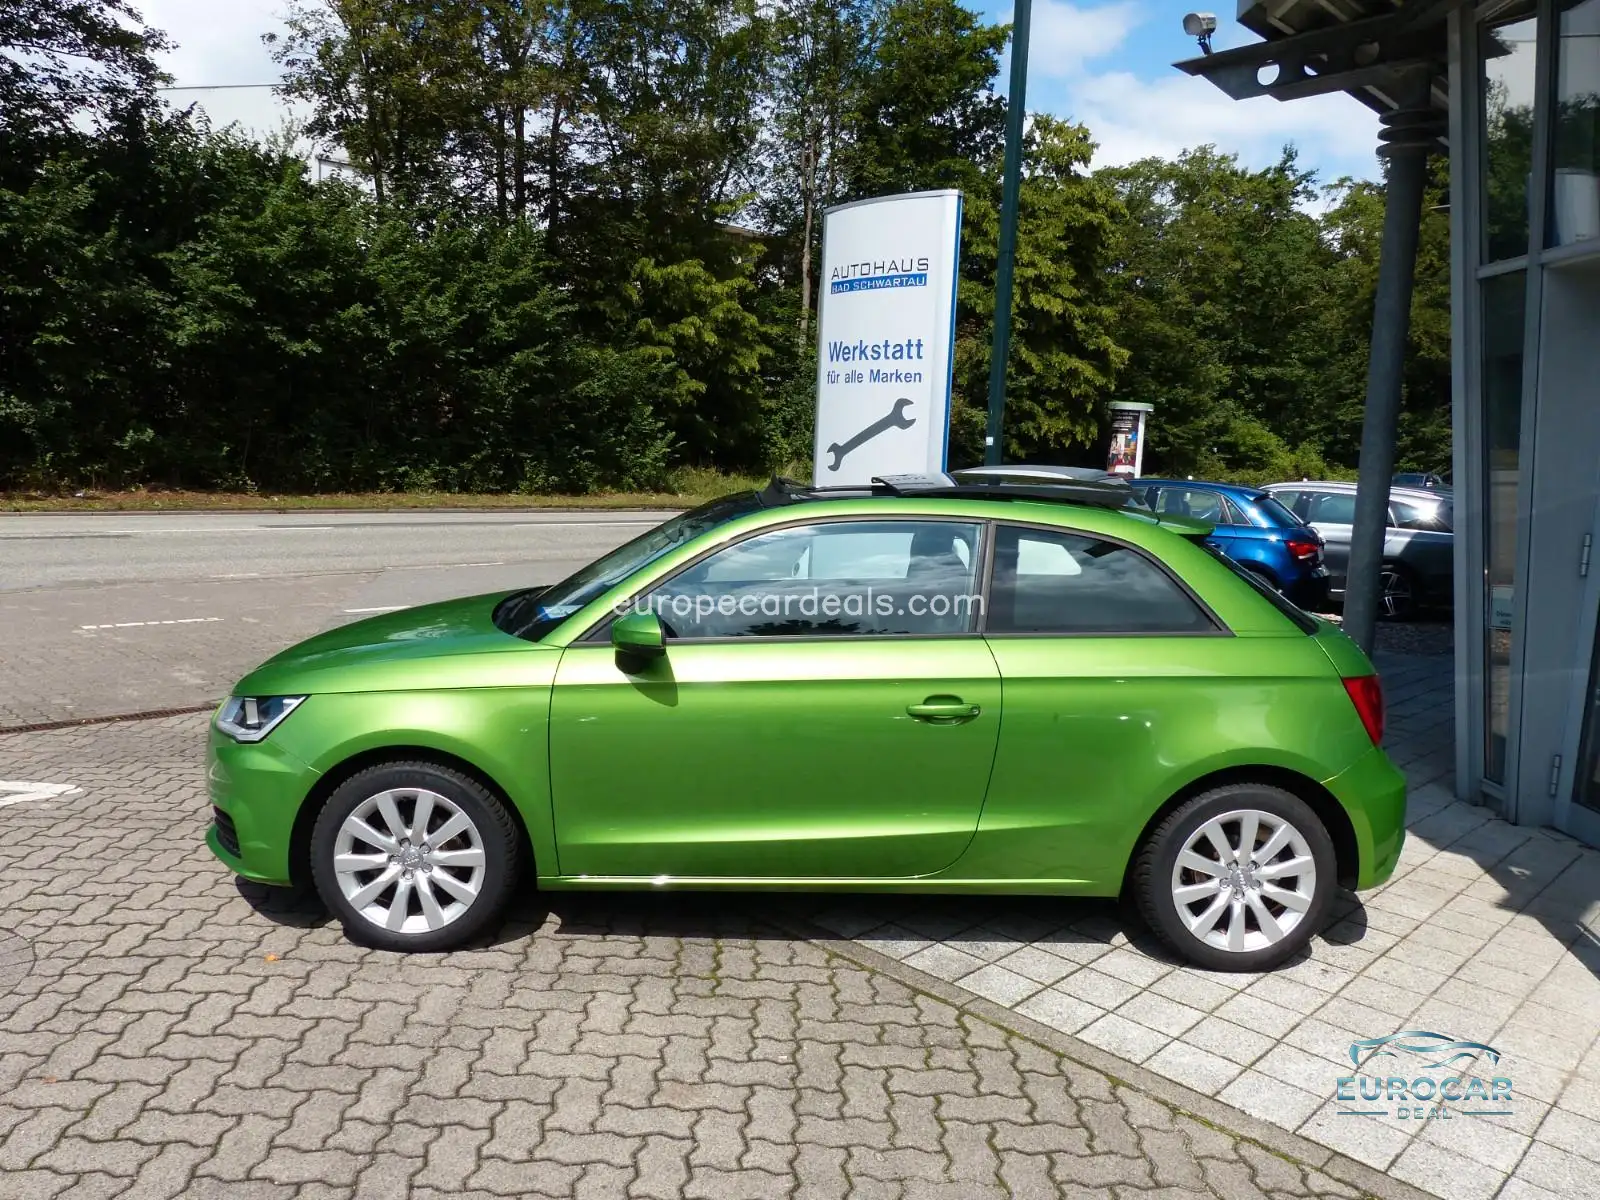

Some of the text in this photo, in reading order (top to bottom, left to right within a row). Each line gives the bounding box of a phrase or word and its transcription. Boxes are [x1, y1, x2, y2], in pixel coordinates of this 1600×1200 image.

[831, 257, 929, 280] AUTOHAUS
[831, 276, 926, 294] BAD SCHWARTAU
[828, 338, 924, 362] Werkstatt
[827, 369, 922, 384] für alle Marken
